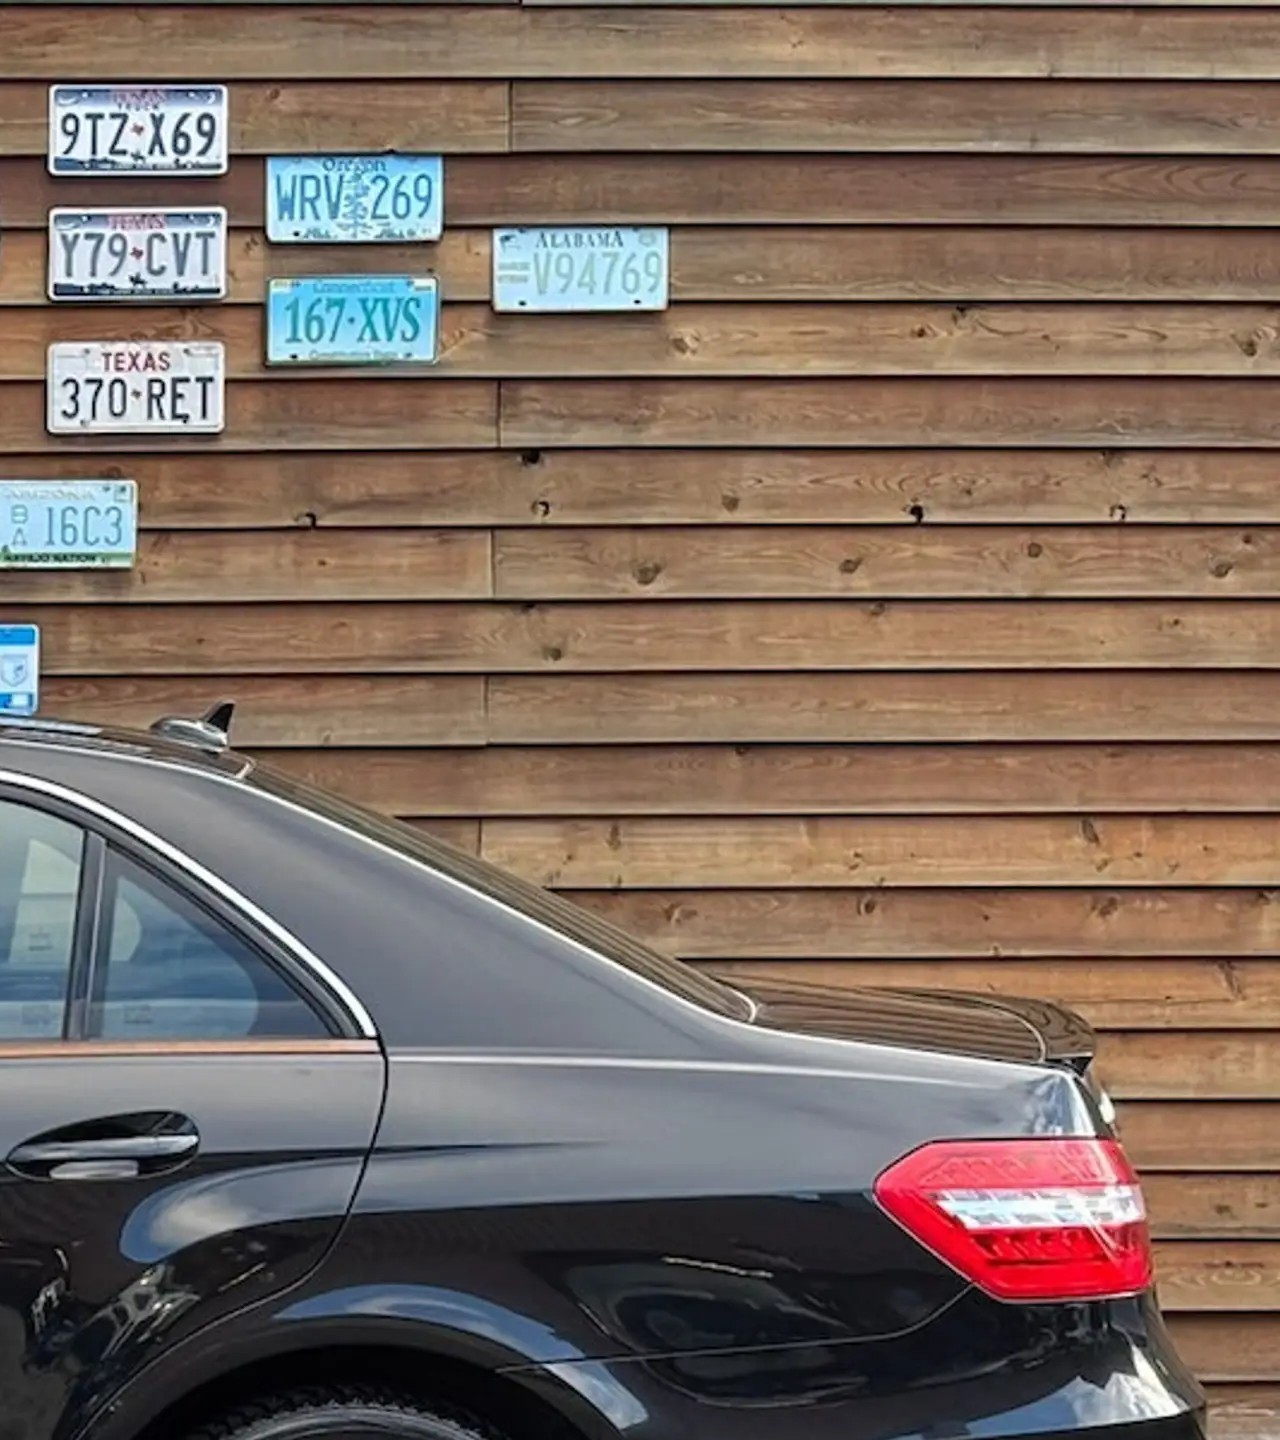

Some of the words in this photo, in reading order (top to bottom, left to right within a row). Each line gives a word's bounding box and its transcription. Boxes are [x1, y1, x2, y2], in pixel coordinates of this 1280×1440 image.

[536, 230, 624, 249] ALABAMA
[533, 251, 662, 296] V94769
[101, 351, 171, 372] TEXAS
